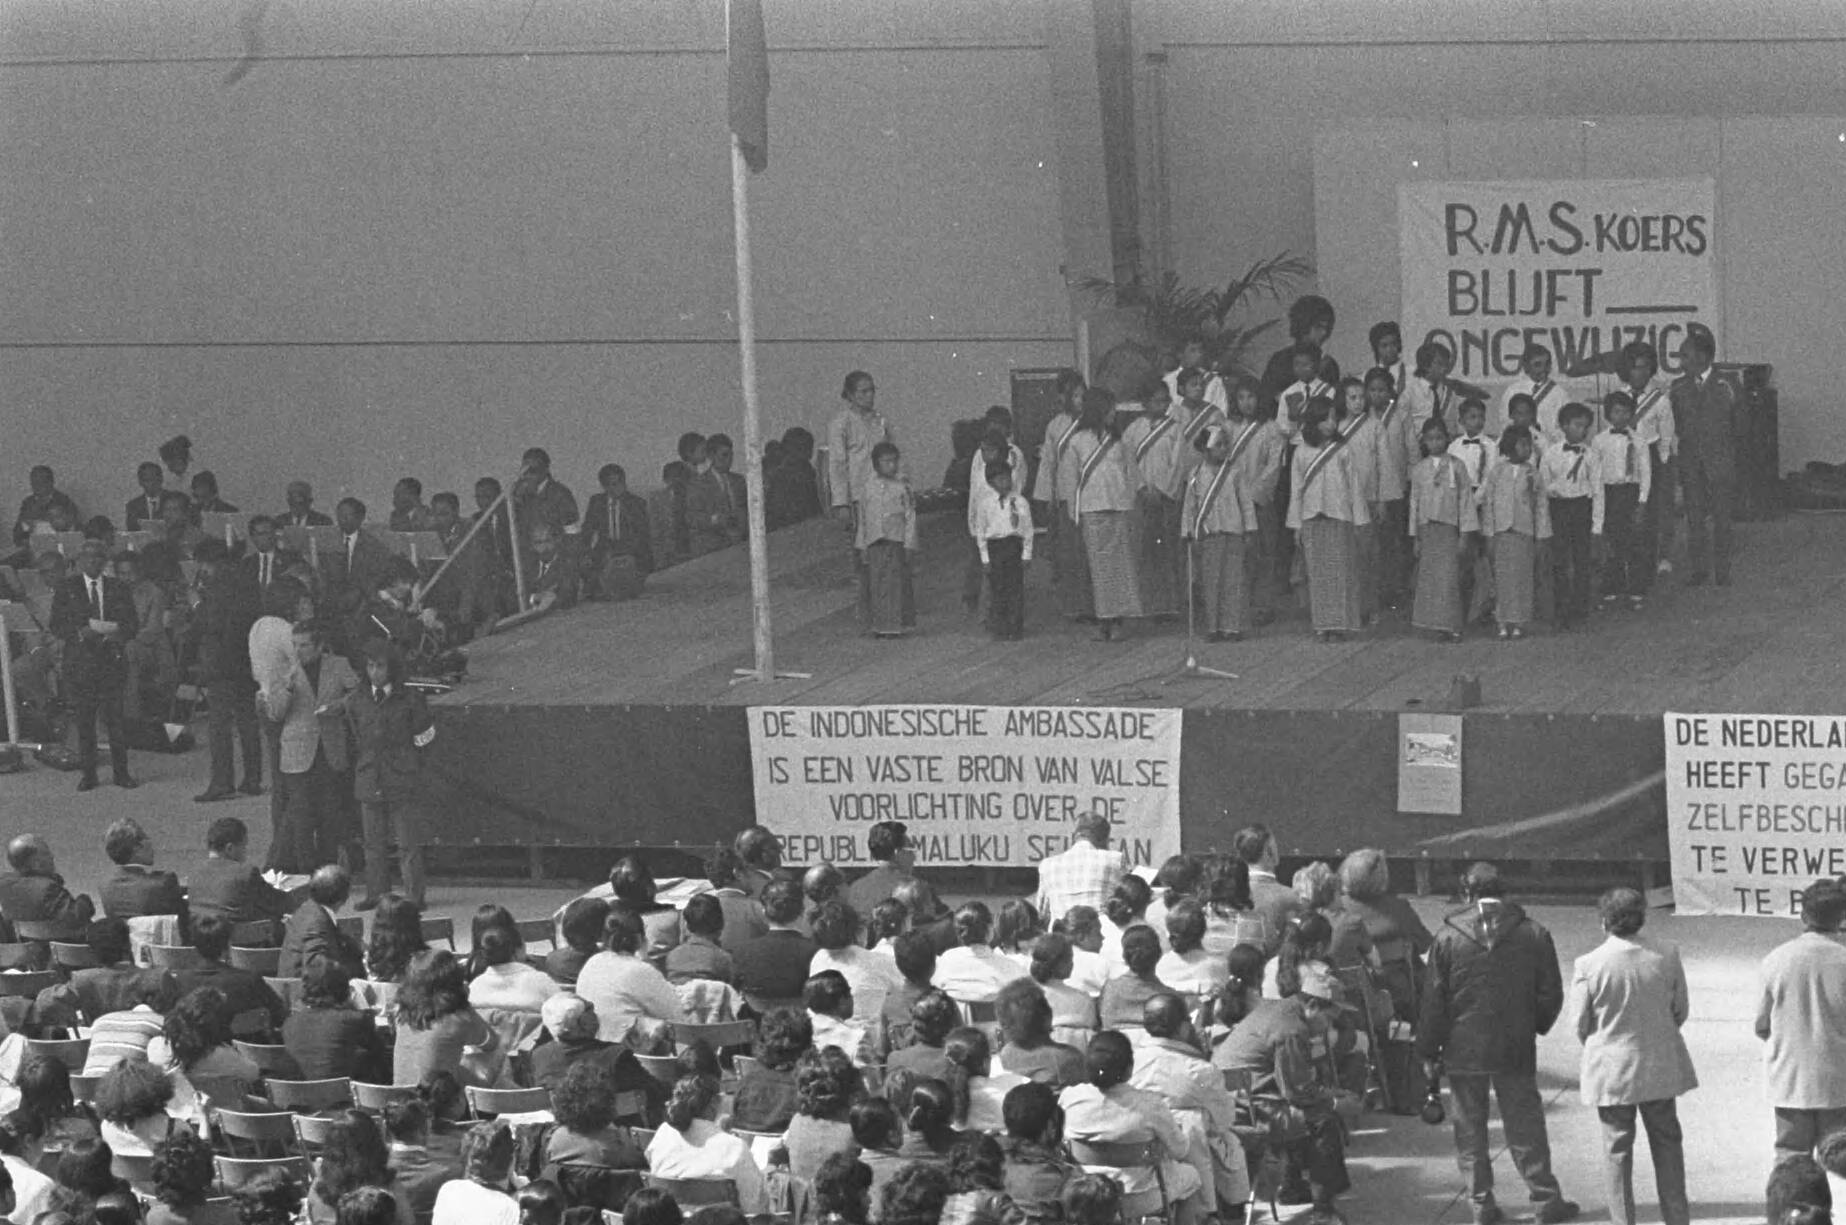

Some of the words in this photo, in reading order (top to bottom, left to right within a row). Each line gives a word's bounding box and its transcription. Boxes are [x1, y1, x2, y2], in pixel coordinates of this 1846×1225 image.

[1445, 201, 1590, 256] R.M.S.
[1594, 213, 1707, 256] KOERS
[1448, 268, 1603, 318] BLIJFT
[763, 711, 797, 738] DE
[811, 709, 987, 739] INDONESISCHE
[1004, 710, 1157, 740] AMBASSADE
[1676, 719, 1708, 746] DE
[768, 757, 789, 784] IS
[804, 756, 852, 784] EEN
[866, 755, 943, 784] VASTE
[958, 755, 1023, 784] BRON
[1034, 756, 1078, 785] VAN
[1090, 757, 1168, 788] VALSE
[1686, 761, 1771, 789] HEEFT
[829, 793, 1002, 821] VOORLICHTING
[1013, 794, 1078, 822] OVER
[1091, 796, 1126, 825] DE
[1690, 846, 1728, 873] TE
[1733, 888, 1774, 915] TE
